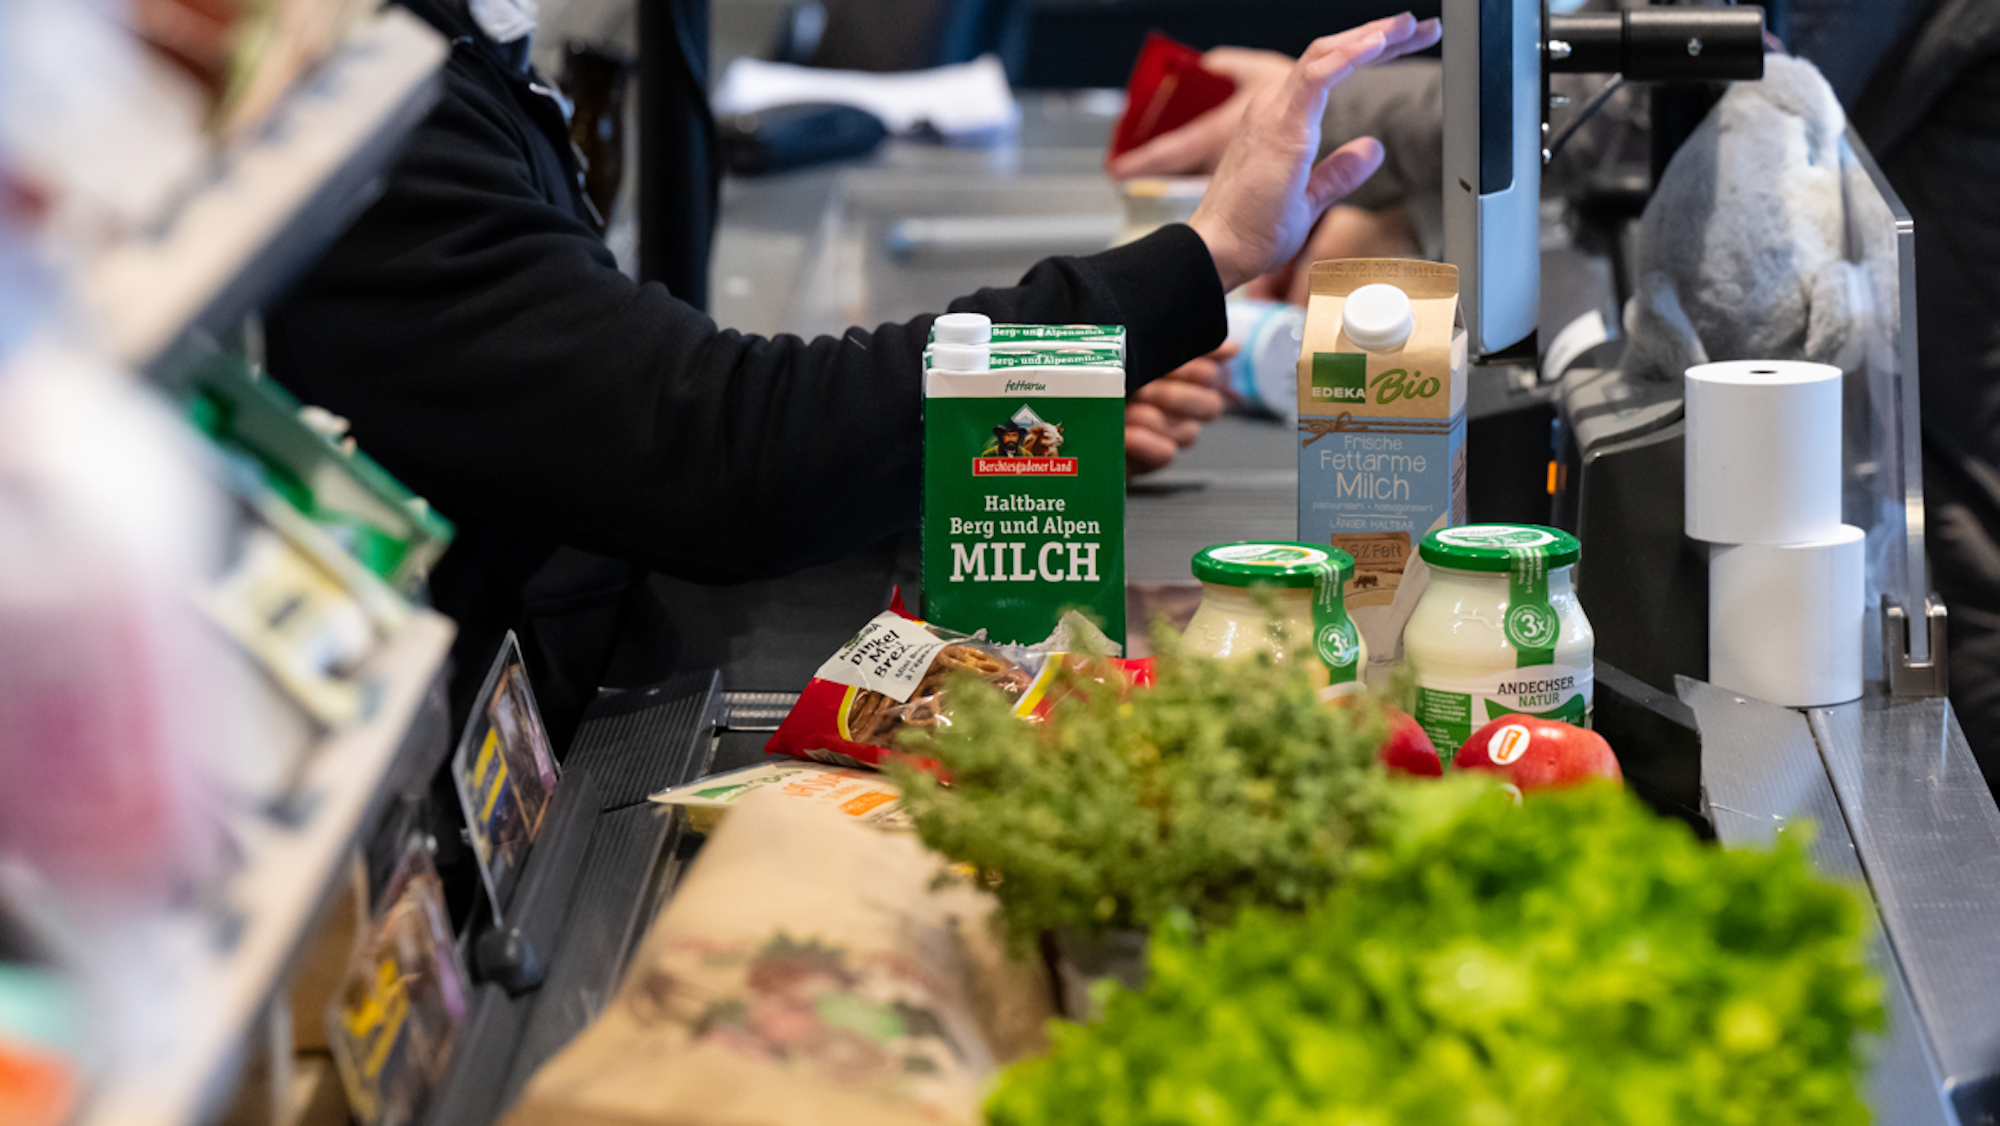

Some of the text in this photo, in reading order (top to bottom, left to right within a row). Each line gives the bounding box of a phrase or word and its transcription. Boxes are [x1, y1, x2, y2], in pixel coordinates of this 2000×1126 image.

[1327, 263, 1399, 277] 05.02.2023
[993, 328, 1020, 337] Berg-
[1045, 328, 1105, 337] Alpenmilch
[990, 354, 1104, 367] Berg- und Alpenmilch
[1311, 368, 1441, 405] EDEKA Bio
[1344, 435, 1403, 451] Frische
[979, 459, 1072, 475] Berchtesgadener Land
[1320, 450, 1427, 473] Fettarme
[1337, 472, 1410, 500] Milch
[984, 494, 1066, 512] Haltbare
[949, 516, 1101, 539] Berg und Alpen
[1329, 518, 1415, 530] LÄNGER HALTBAR
[1373, 543, 1403, 558] Fett
[949, 541, 1101, 582] MILCH
[1520, 614, 1546, 638] 3x
[851, 629, 900, 667] Dinkel
[1497, 676, 1575, 695] ANDECHSER
[1518, 692, 1560, 708] NATUR
